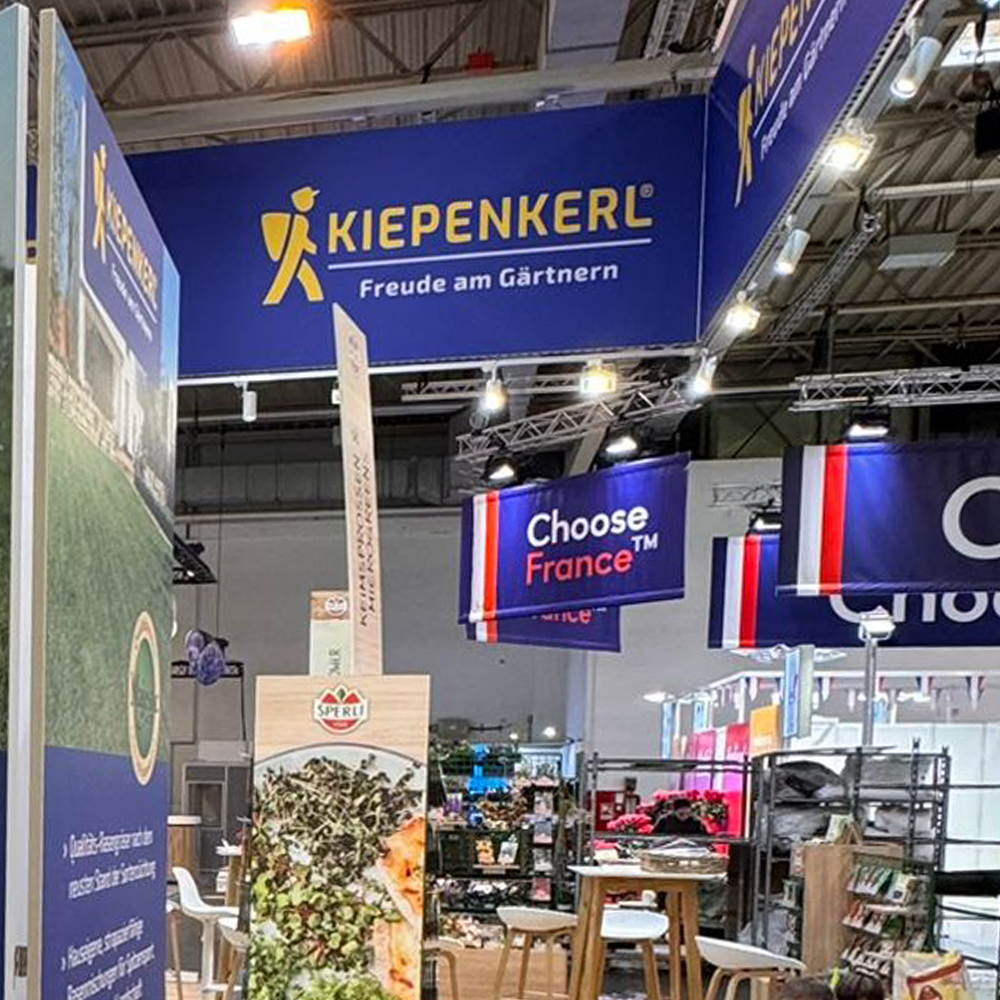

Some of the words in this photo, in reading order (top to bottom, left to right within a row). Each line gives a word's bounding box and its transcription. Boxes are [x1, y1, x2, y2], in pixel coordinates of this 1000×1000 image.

[359, 274, 447, 299] Freude
[453, 273, 493, 293] am
[499, 262, 619, 288] Gärtnern
[527, 504, 649, 549] Choose
[525, 548, 634, 587] France
